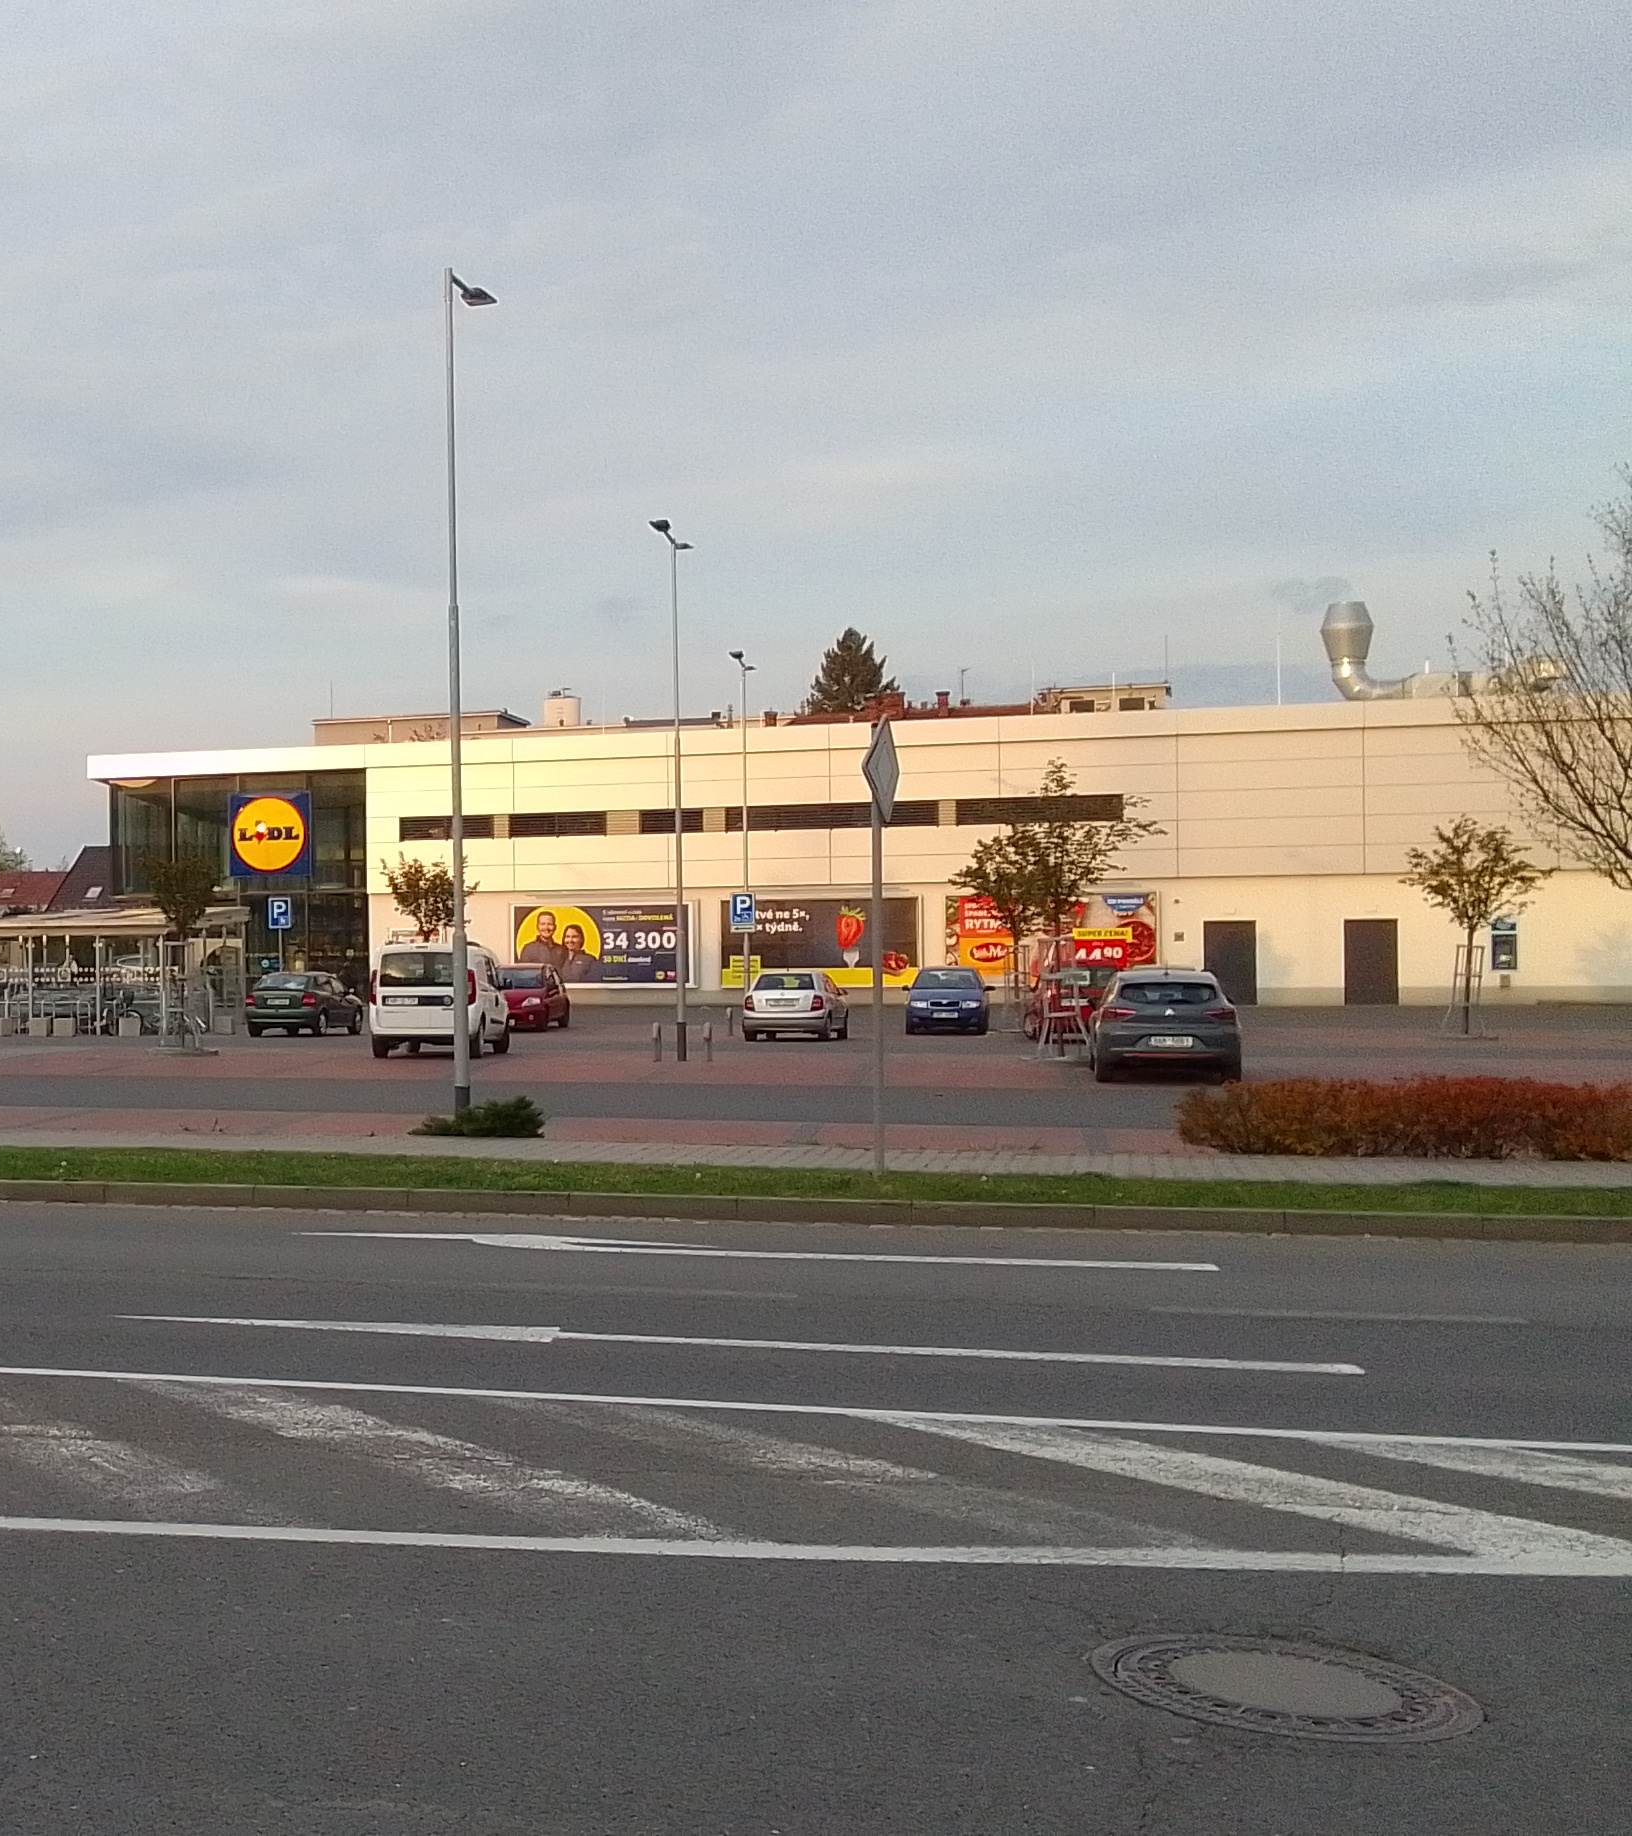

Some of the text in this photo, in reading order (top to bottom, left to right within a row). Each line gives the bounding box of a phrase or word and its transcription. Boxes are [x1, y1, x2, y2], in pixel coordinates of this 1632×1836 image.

[273, 901, 287, 919] P
[736, 896, 751, 915] P
[775, 910, 790, 919] ne
[603, 931, 677, 950] 34 300
